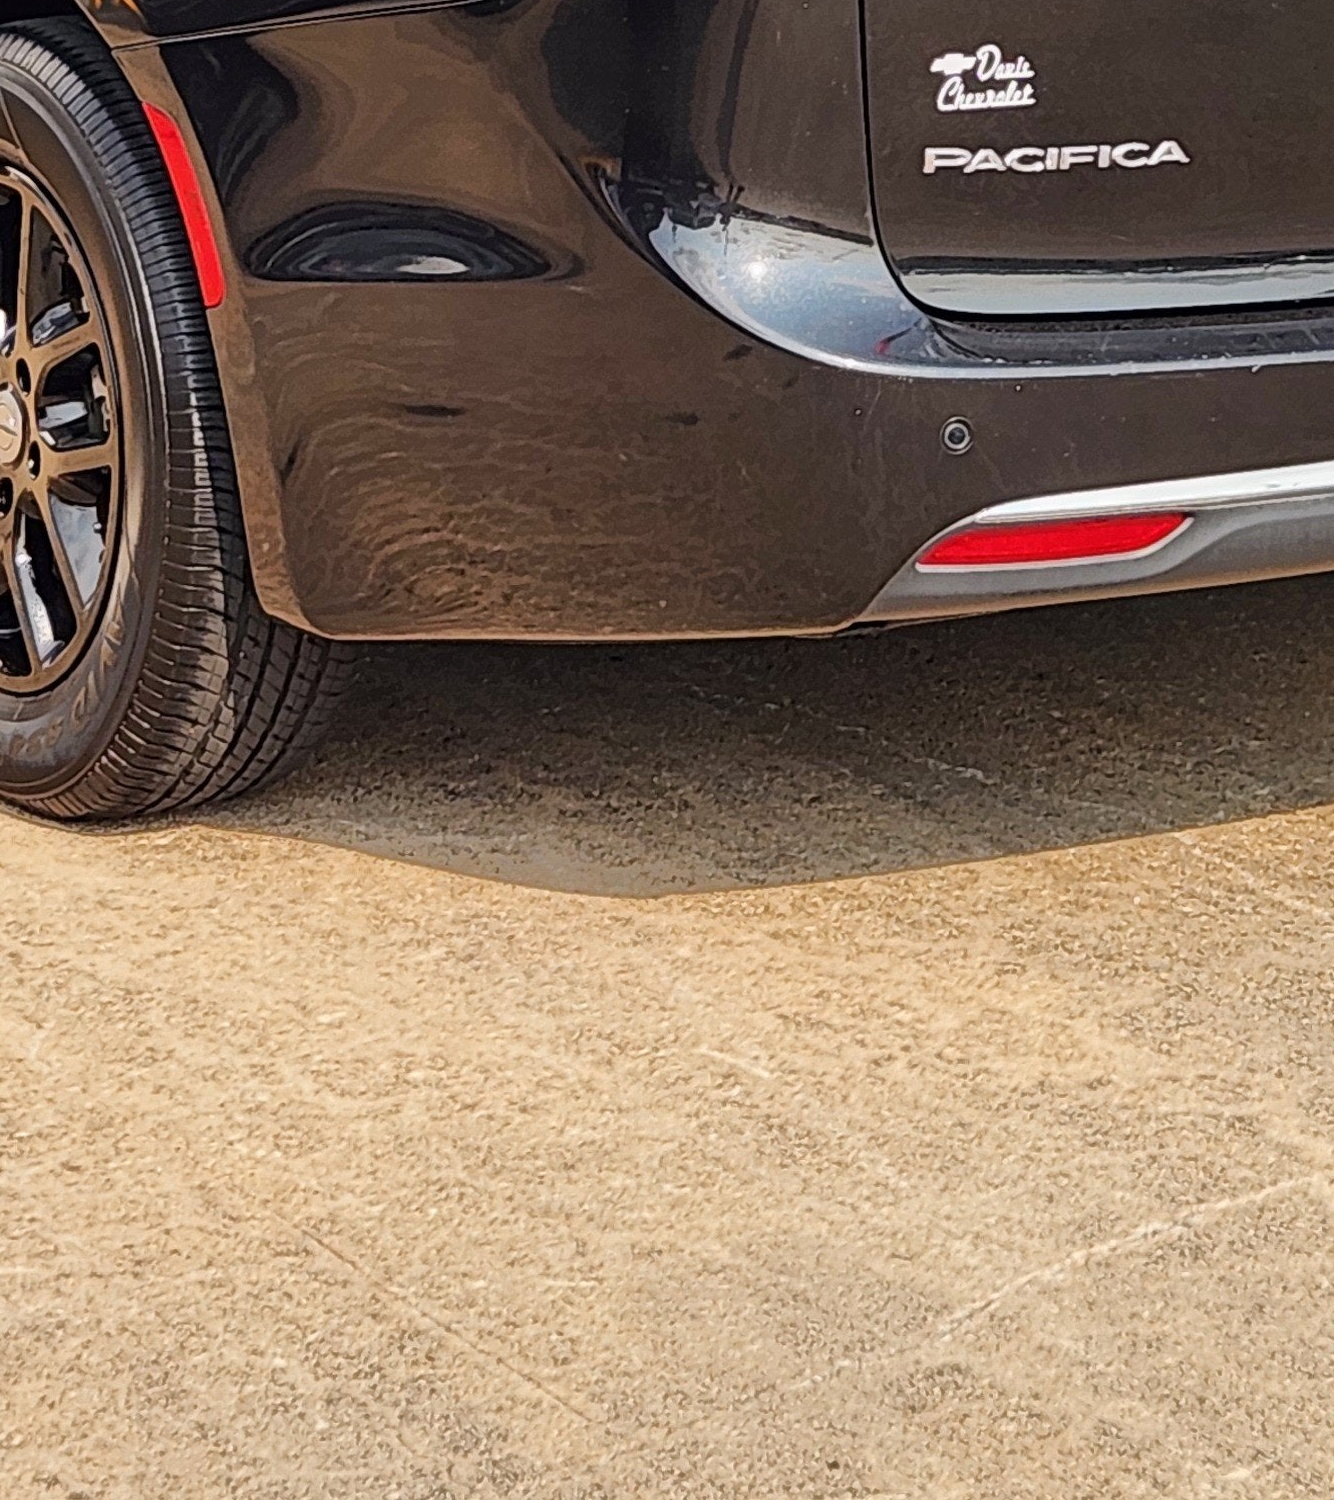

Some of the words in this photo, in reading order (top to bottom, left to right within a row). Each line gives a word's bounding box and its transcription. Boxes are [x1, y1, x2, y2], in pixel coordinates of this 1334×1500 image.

[975, 44, 1036, 82] Davis
[937, 76, 1037, 112] Chevrolet
[922, 140, 1191, 174] PACIFICA
